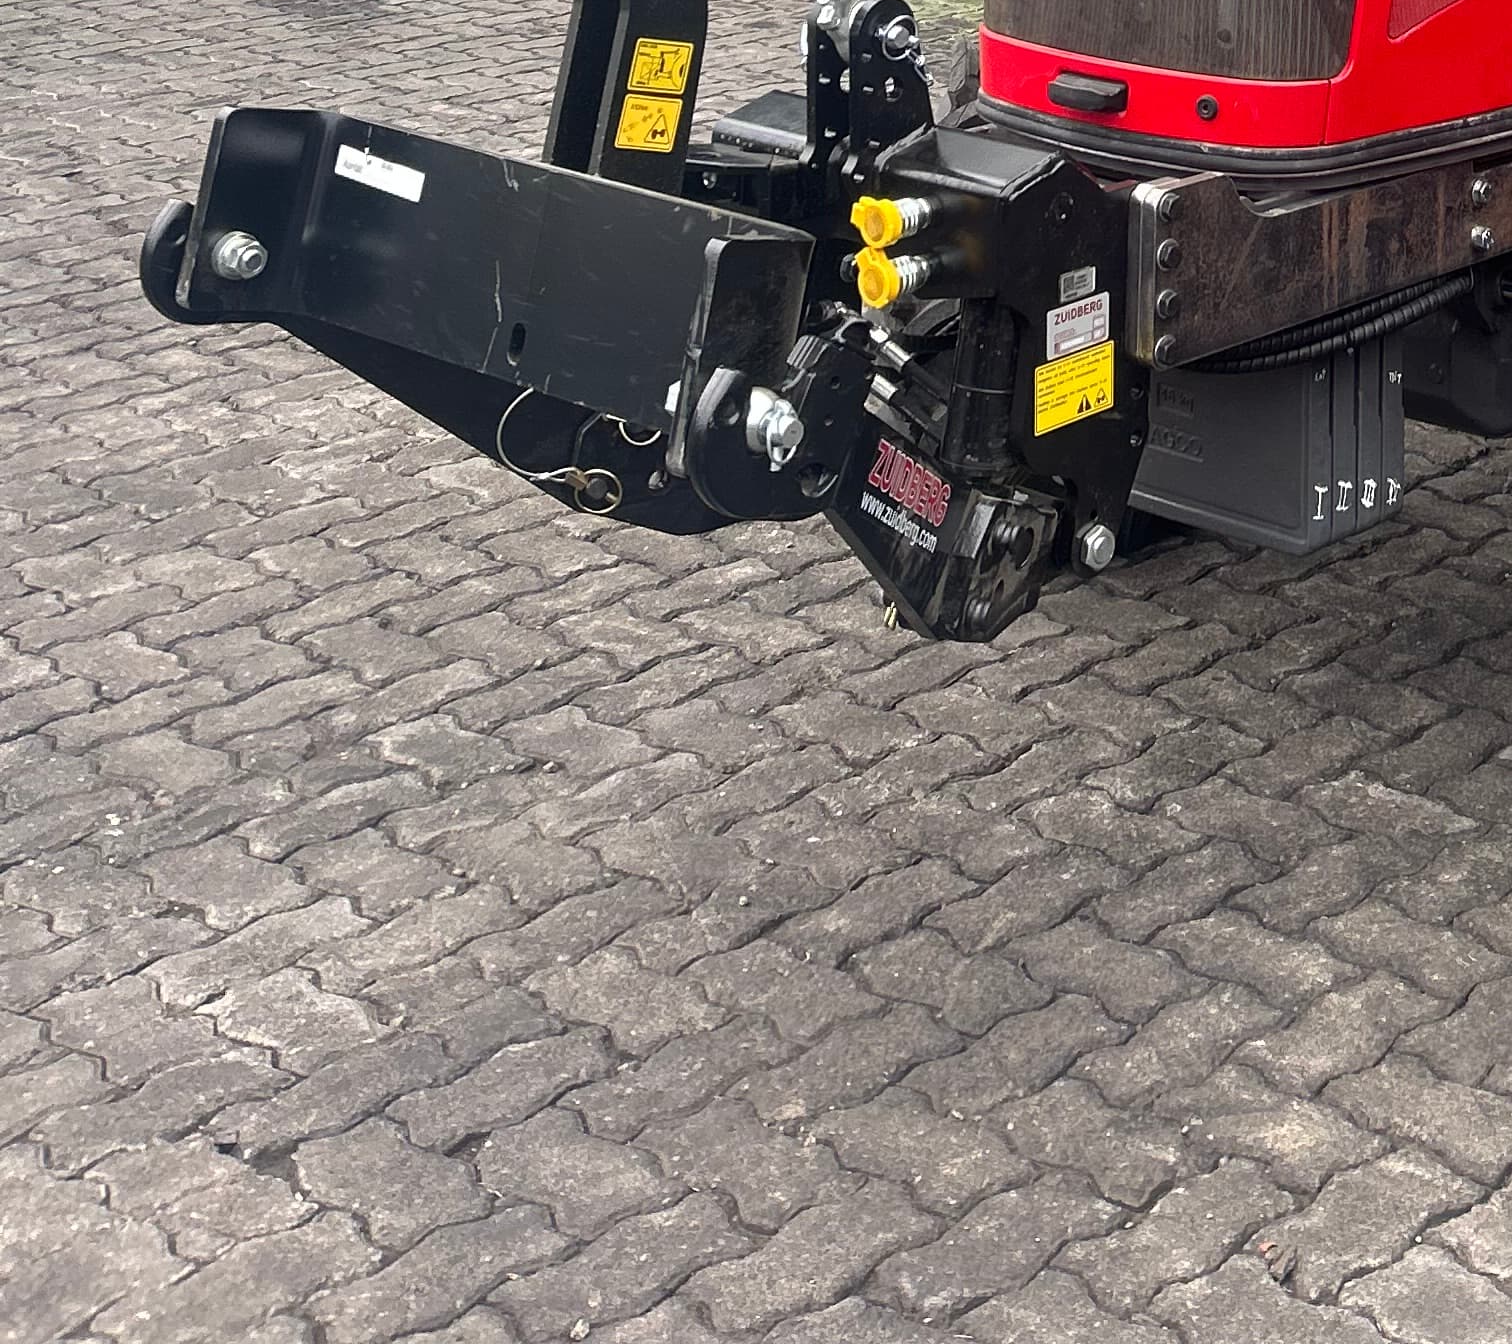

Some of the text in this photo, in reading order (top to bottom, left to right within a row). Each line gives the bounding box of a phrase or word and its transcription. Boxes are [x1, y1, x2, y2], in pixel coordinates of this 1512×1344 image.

[1054, 299, 1103, 326] ZUIDBERG
[868, 438, 951, 527] ZUIDBERG
[860, 491, 938, 553] www.zuidberg.com
